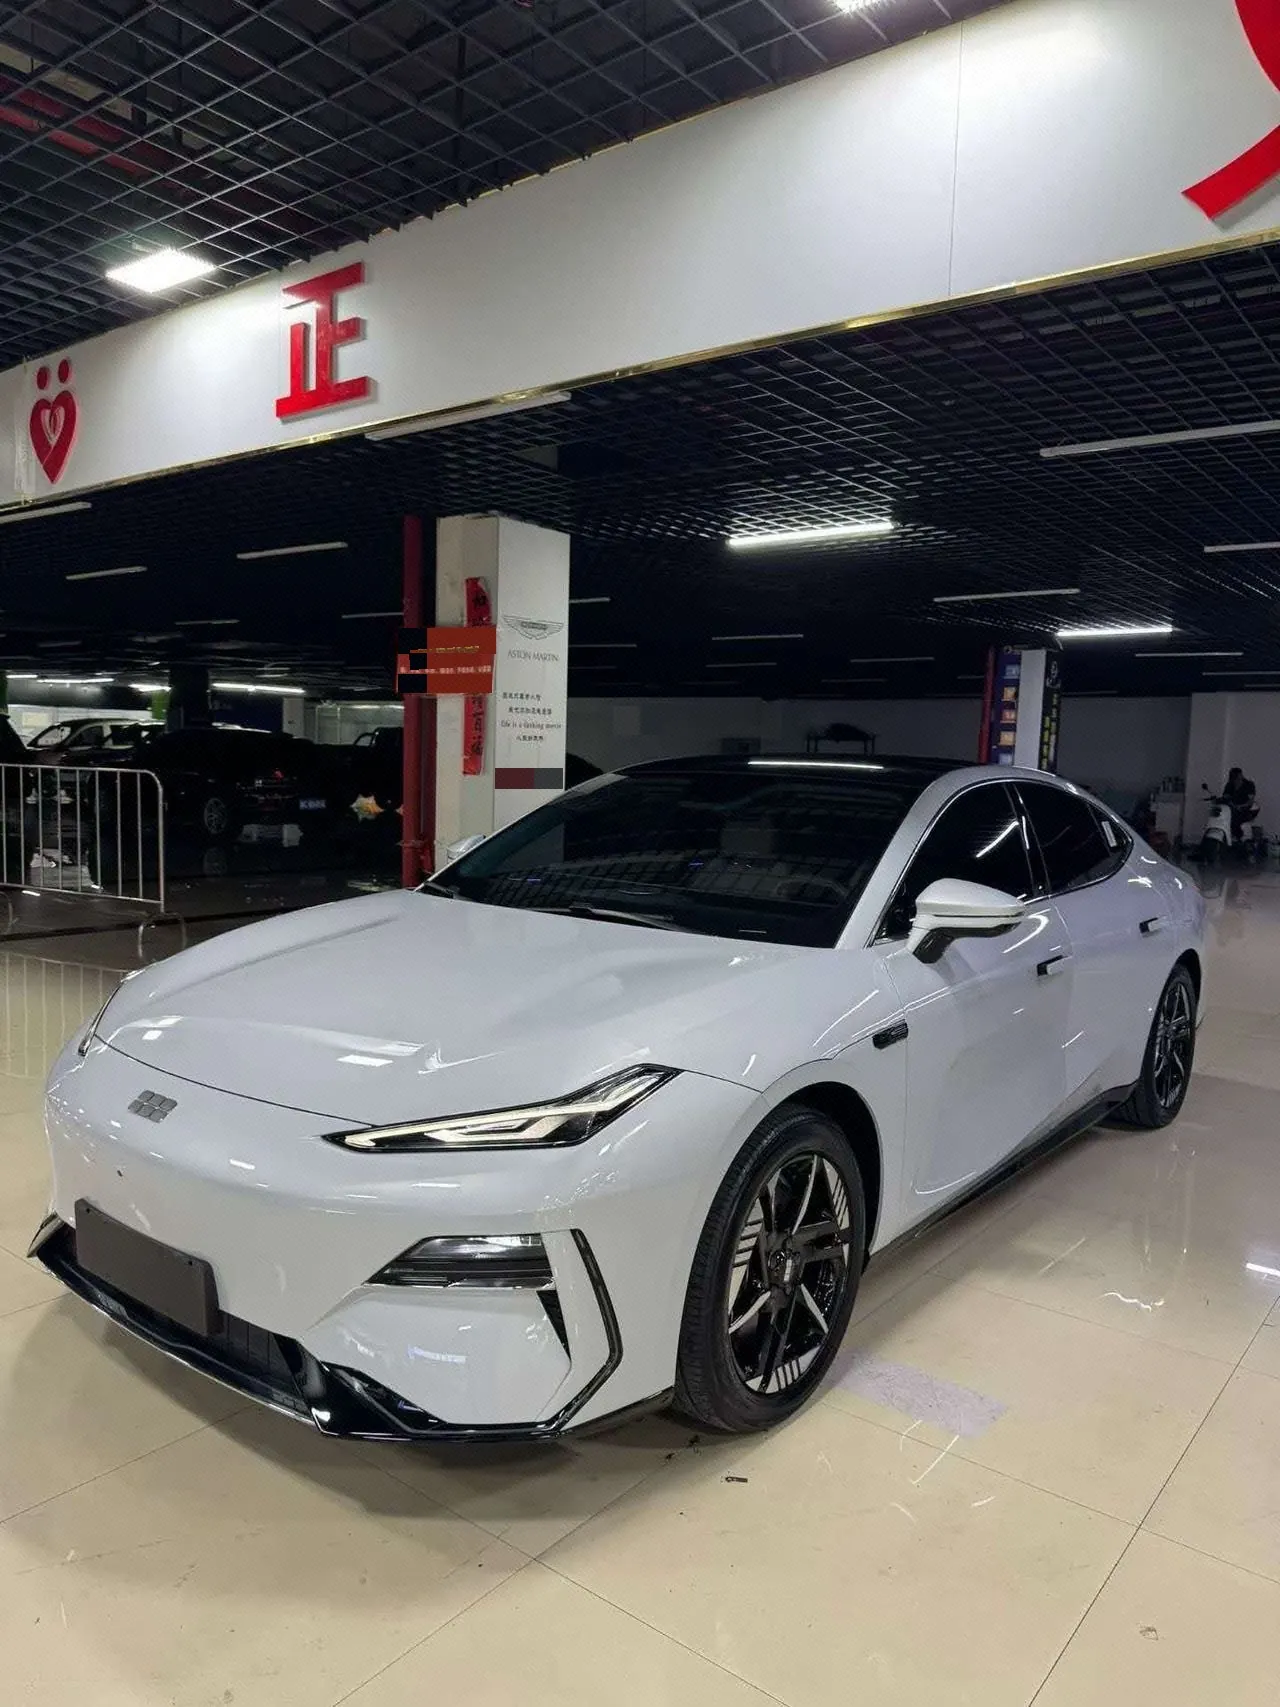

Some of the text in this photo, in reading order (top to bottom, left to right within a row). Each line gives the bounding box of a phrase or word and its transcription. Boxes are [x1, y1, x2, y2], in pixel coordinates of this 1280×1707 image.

[275, 262, 370, 418] 正
[507, 648, 560, 662] ASTON MARTIN
